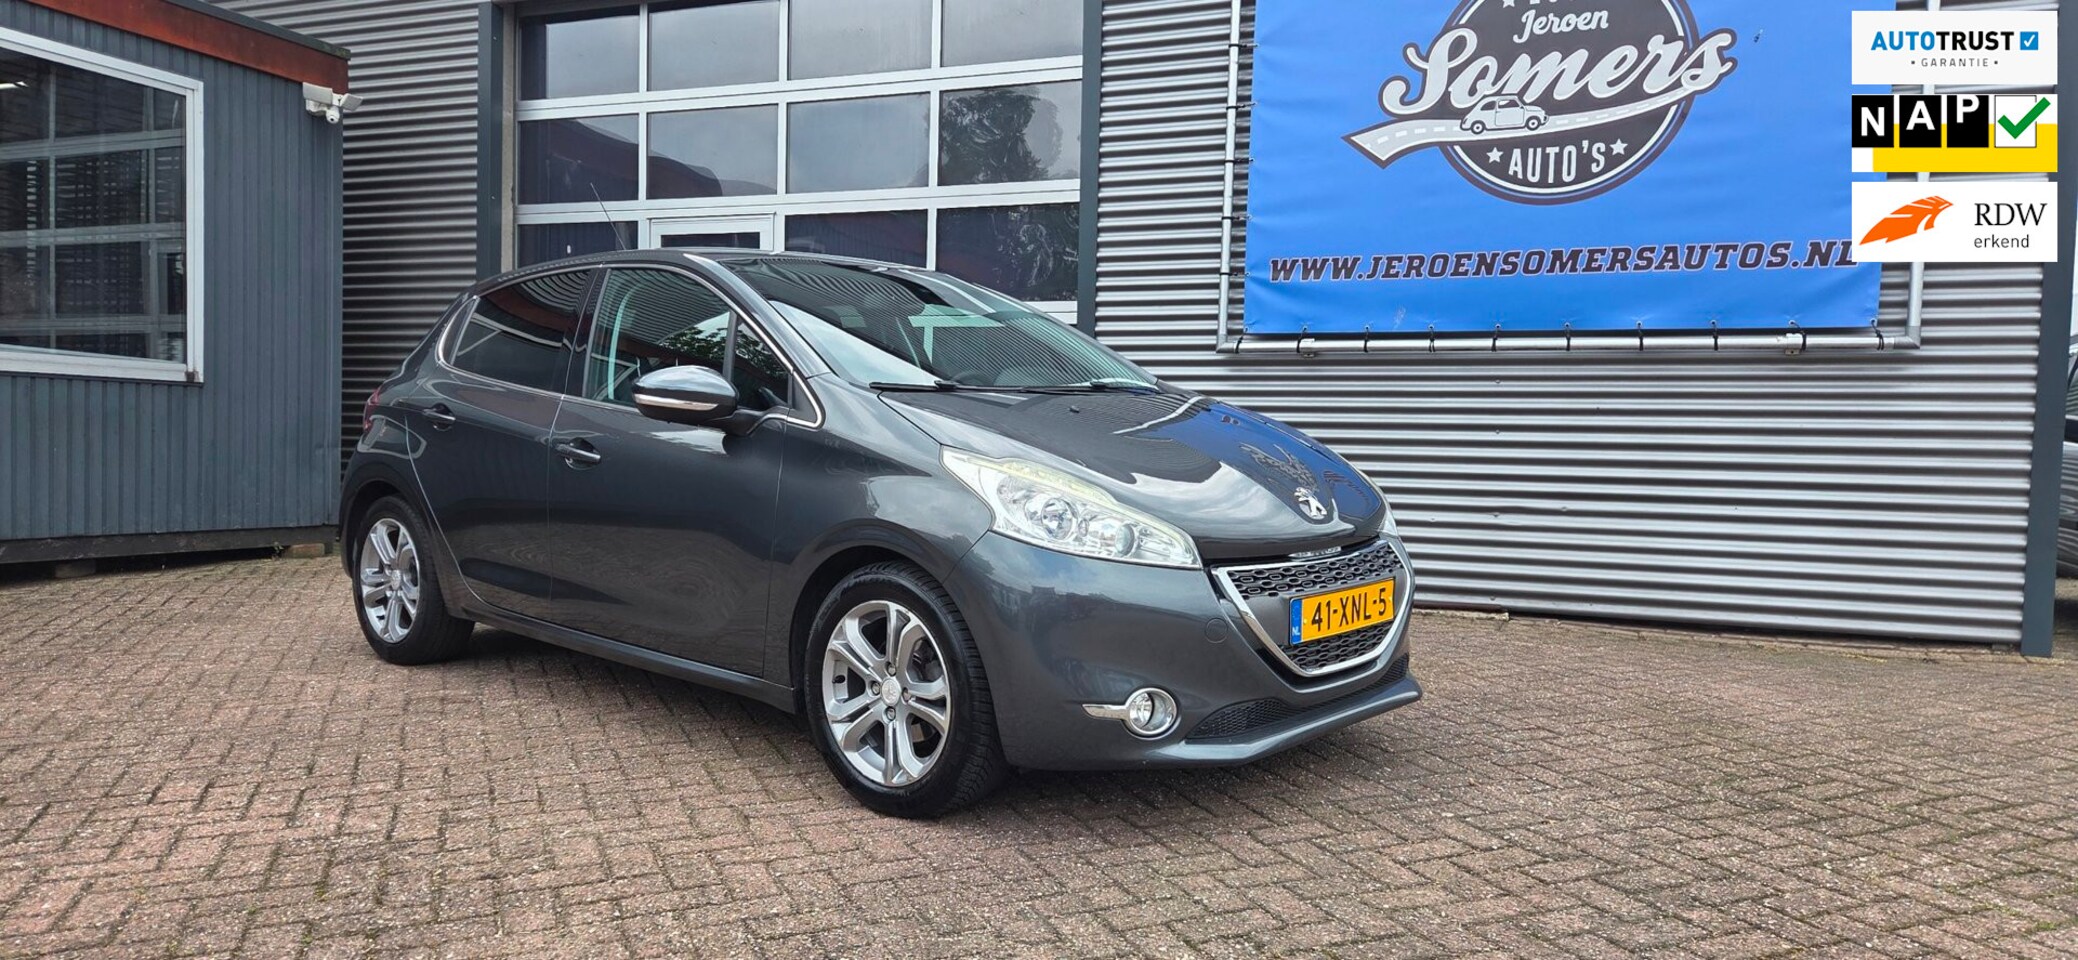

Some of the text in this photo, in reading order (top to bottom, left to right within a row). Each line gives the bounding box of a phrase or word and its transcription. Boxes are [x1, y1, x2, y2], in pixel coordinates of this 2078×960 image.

[1512, 9, 1609, 44] Jeroen
[1382, 27, 1733, 115] Somers
[1508, 139, 1607, 184] AUTO'S
[1269, 239, 1859, 284] WWW.JEROENSOMERSAUTOS.NL
[1311, 587, 1387, 633] 41-XNL-5
